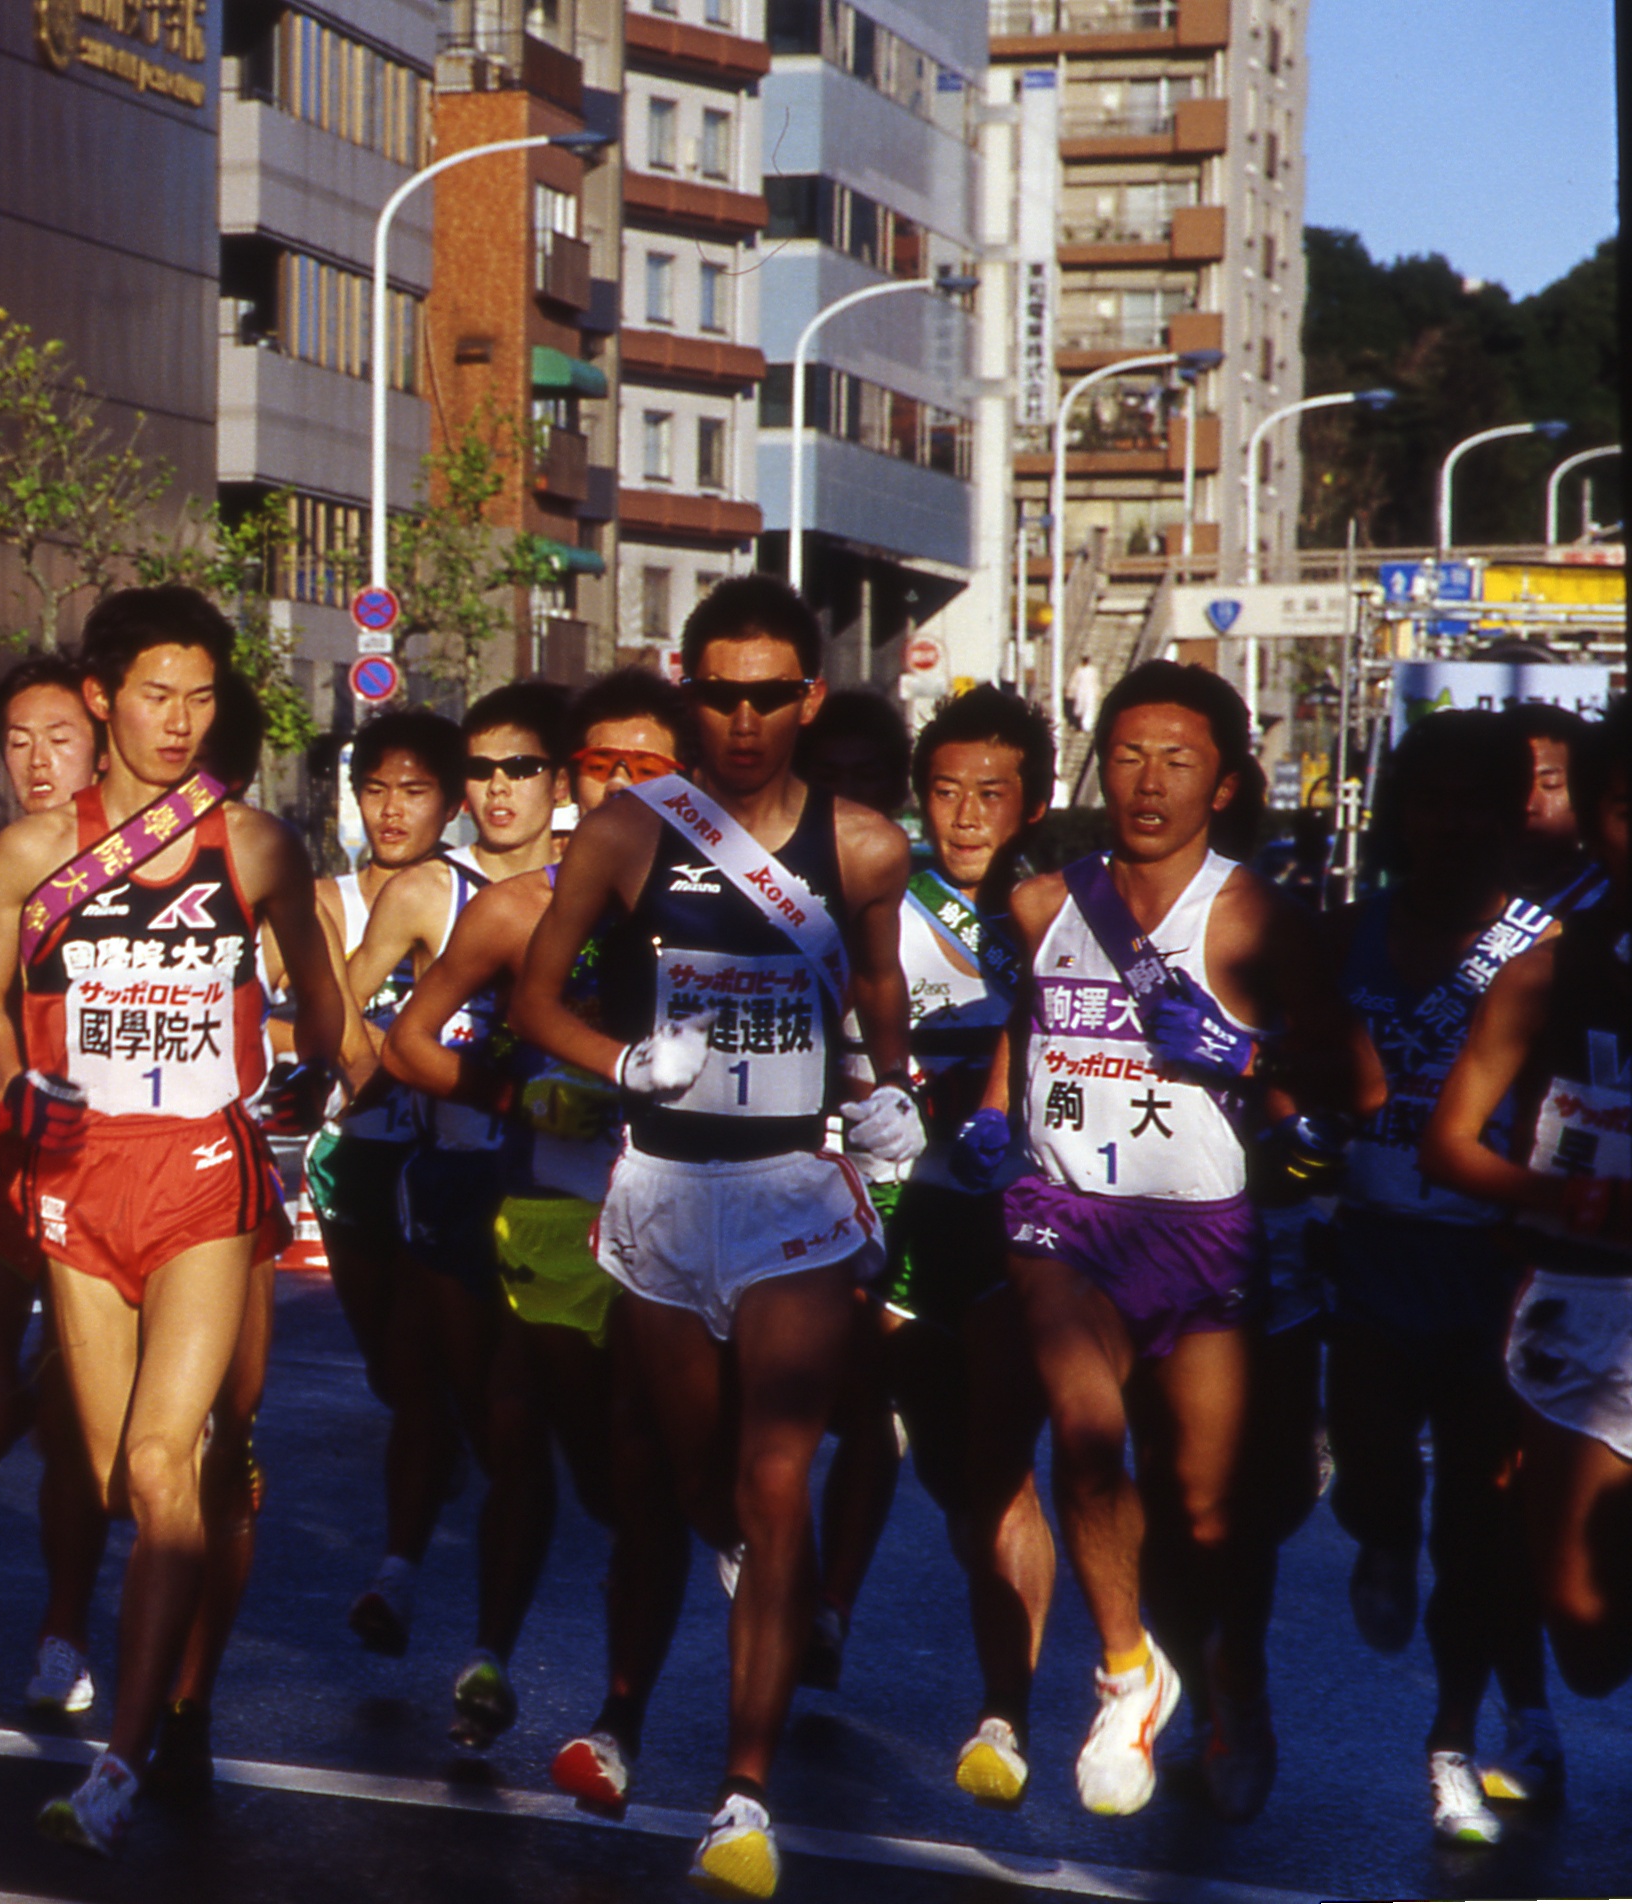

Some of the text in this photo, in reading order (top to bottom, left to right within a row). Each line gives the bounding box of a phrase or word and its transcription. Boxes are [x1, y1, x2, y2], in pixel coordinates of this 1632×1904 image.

[79, 979, 225, 1006] サッポロビール
[668, 964, 812, 995] サッポロビール
[79, 1007, 223, 1063] 國學院大
[141, 1066, 163, 1108] 1
[728, 1060, 750, 1106] 1
[1044, 1050, 1174, 1084] サッポロビー
[1096, 1141, 1118, 1186] 1
